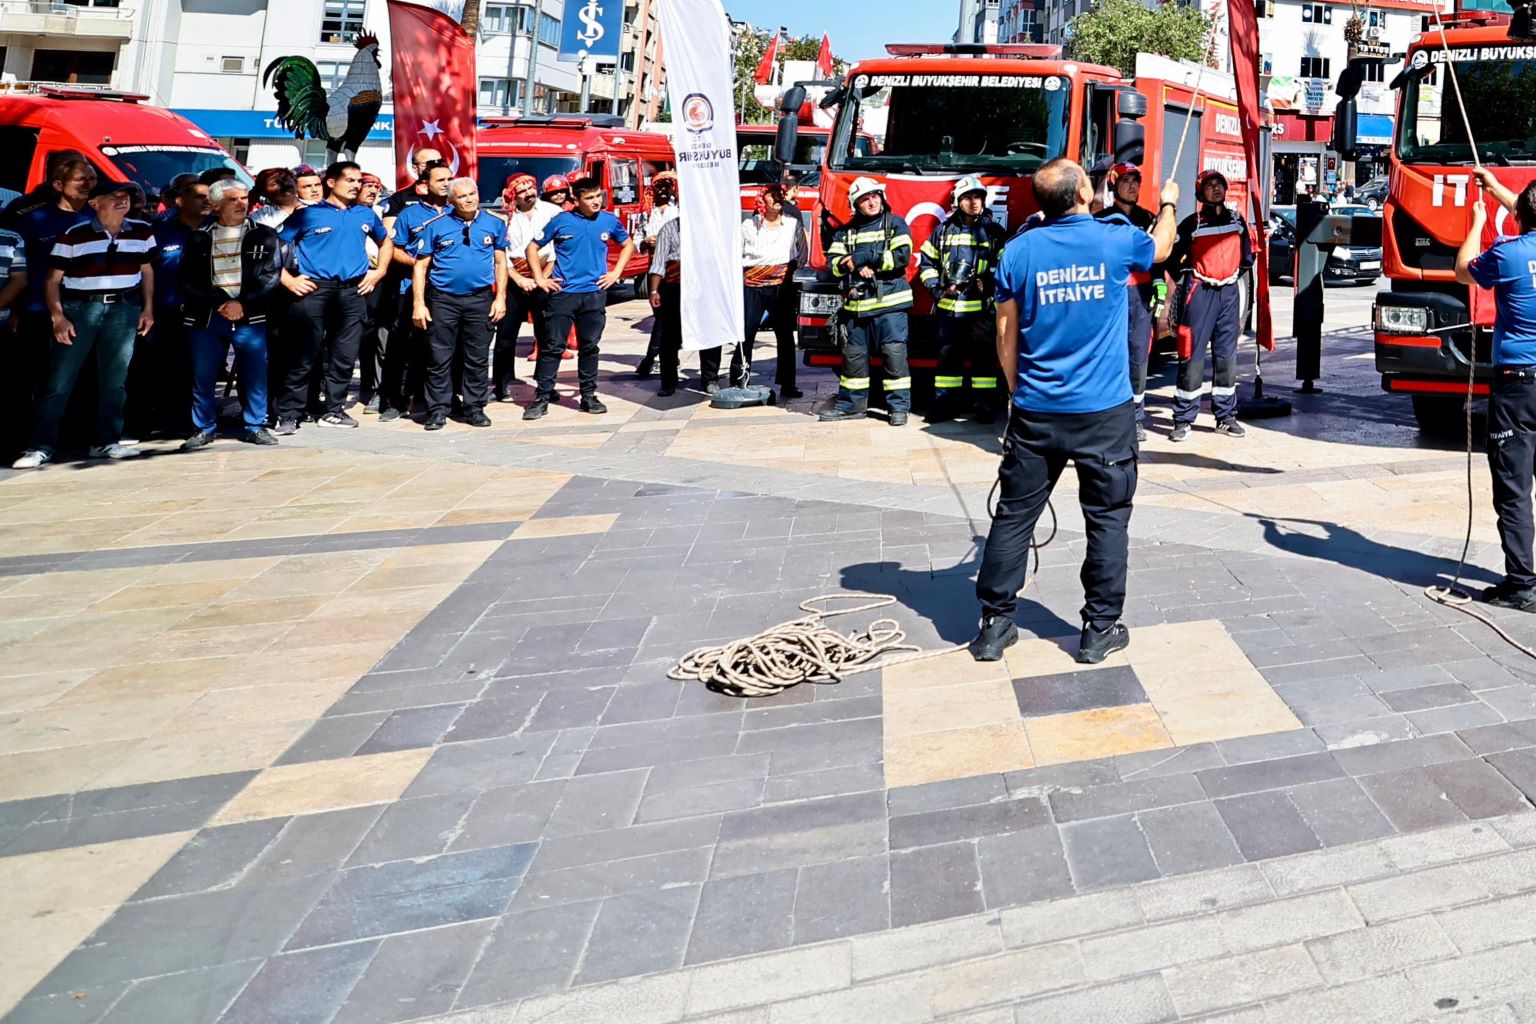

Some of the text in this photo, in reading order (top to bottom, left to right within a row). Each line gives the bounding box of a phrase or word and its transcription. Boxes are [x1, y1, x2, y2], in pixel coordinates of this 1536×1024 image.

[1430, 49, 1477, 63] DENİZLİ
[870, 75, 1042, 89] DENİZLİ BÜYÜKŞEHİR BELEDİYESİ
[1036, 262, 1106, 287] DENİZLİ
[1039, 282, 1106, 306] İTFAİYE
